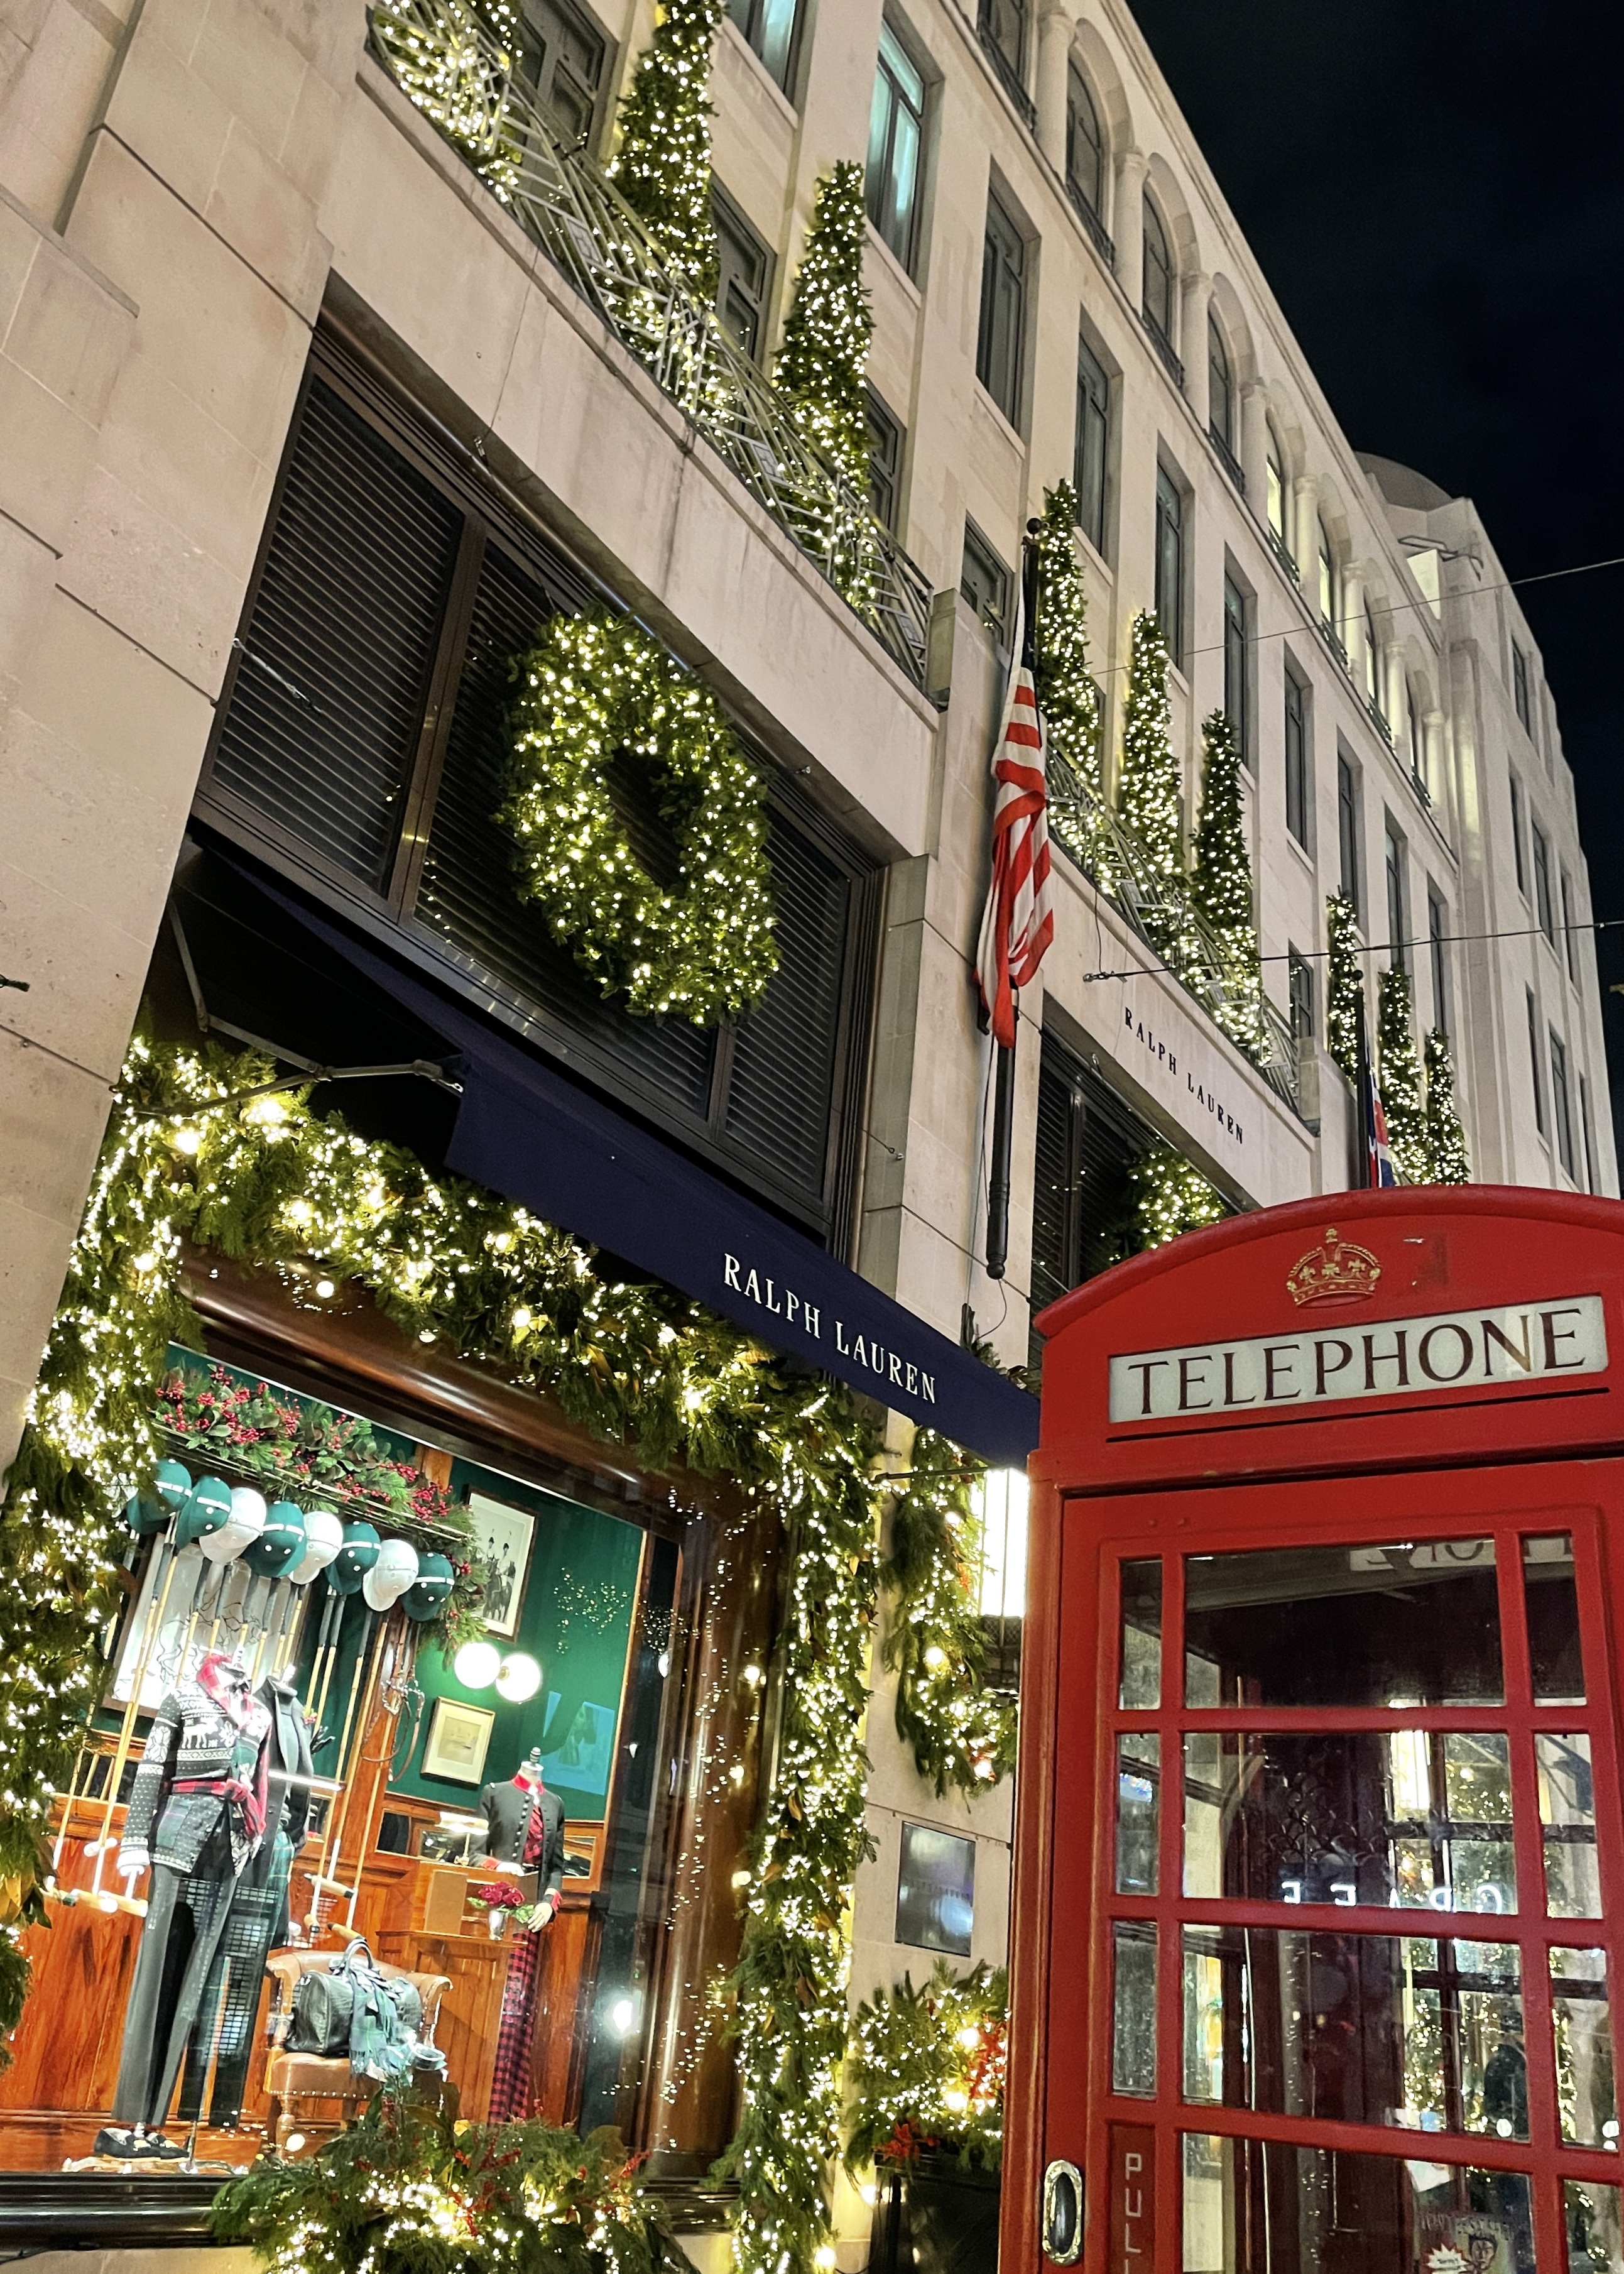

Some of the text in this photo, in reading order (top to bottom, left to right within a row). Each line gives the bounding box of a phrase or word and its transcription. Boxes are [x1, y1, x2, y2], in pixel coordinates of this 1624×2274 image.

[1125, 1007, 1243, 1144] RALPH LAUREN
[724, 1253, 936, 1404] RALPH LAUREN
[1127, 1308, 1586, 1415] TELEPHONE
